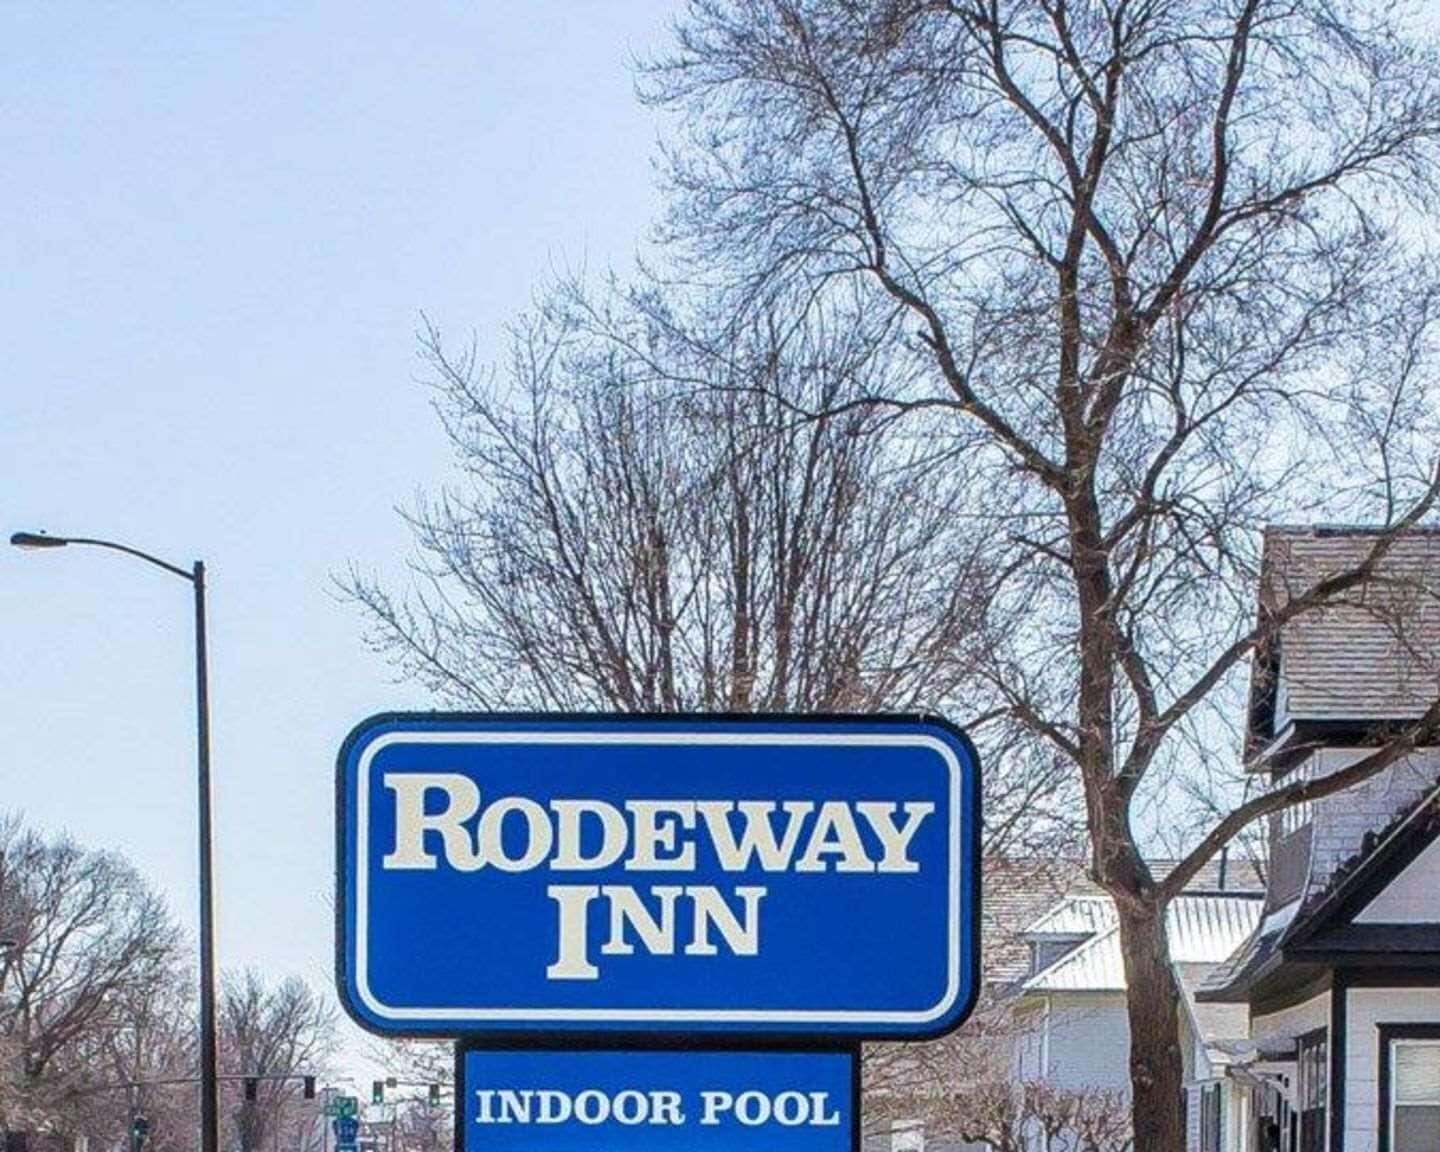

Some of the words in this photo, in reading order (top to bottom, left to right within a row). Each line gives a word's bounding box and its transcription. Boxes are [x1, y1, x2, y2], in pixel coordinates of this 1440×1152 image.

[383, 772, 935, 873] RODEWAY
[546, 884, 768, 981] INN
[475, 1089, 686, 1125] INDOOR
[700, 1091, 840, 1126] POOL
